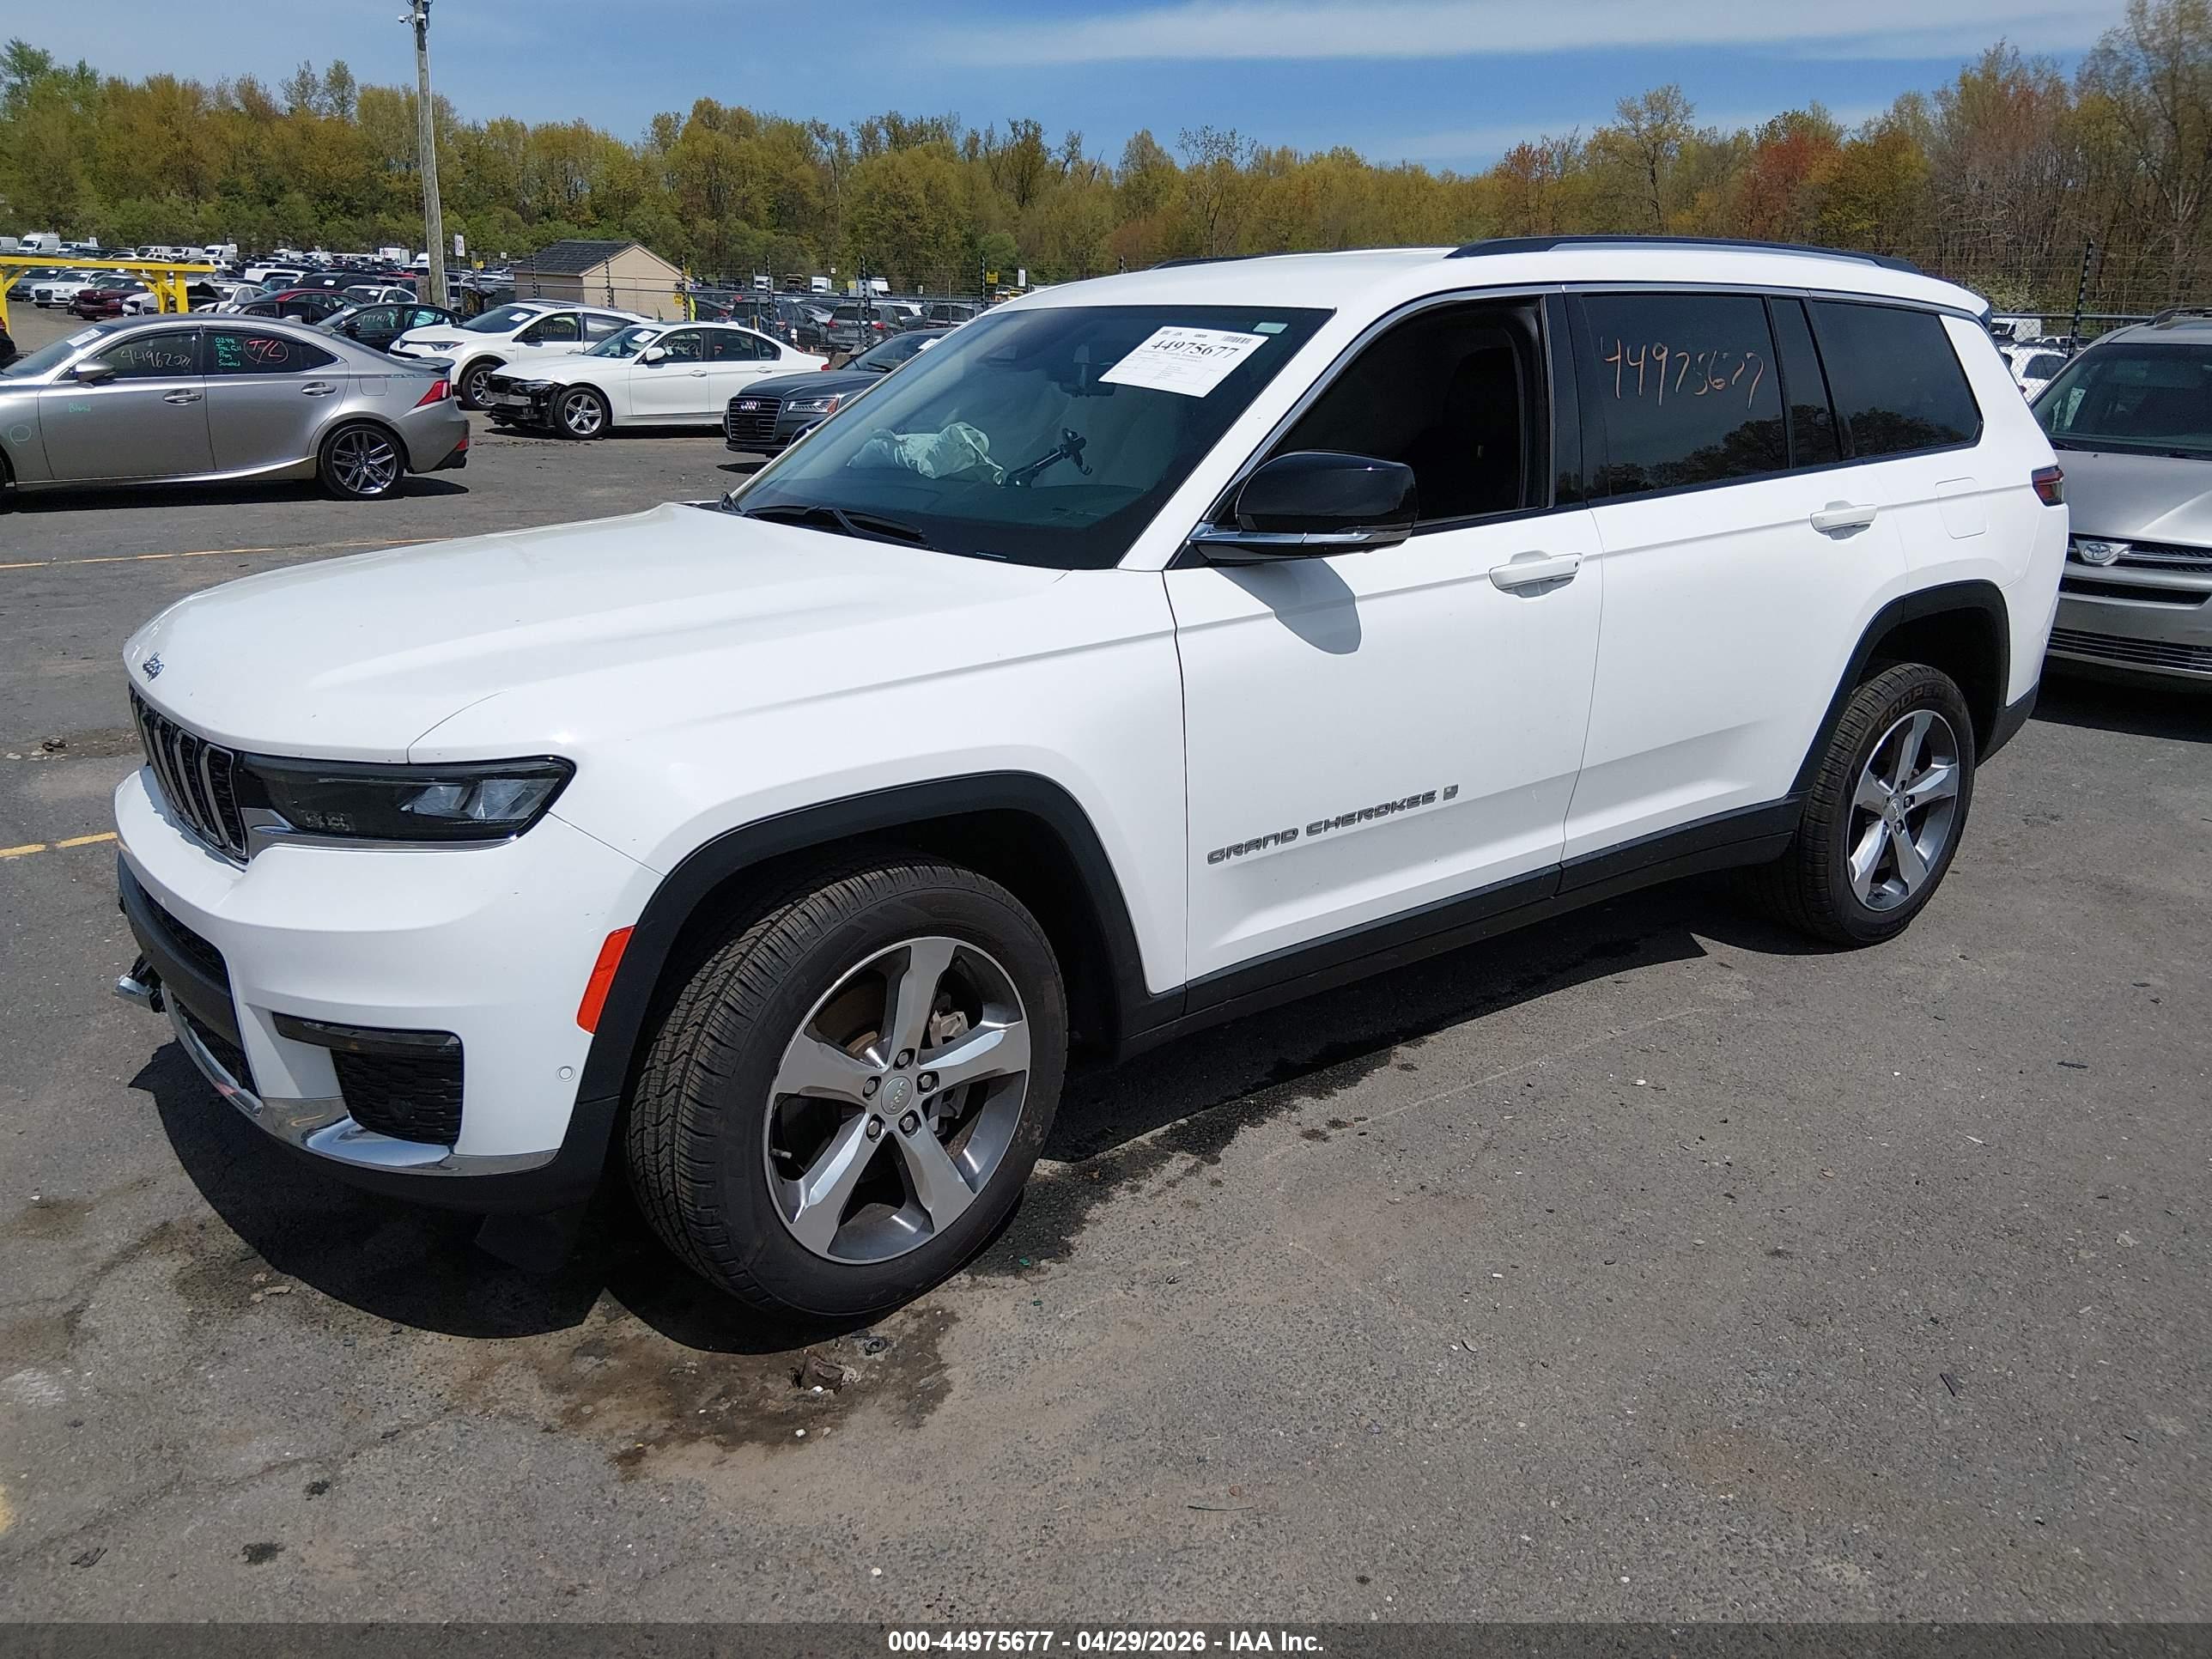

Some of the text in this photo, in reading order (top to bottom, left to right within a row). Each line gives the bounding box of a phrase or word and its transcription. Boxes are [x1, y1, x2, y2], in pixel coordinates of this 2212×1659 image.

[1152, 339, 1242, 359] 44975677
[1206, 827, 1298, 865] GRAND
[1305, 789, 1437, 836] CHEROKEE
